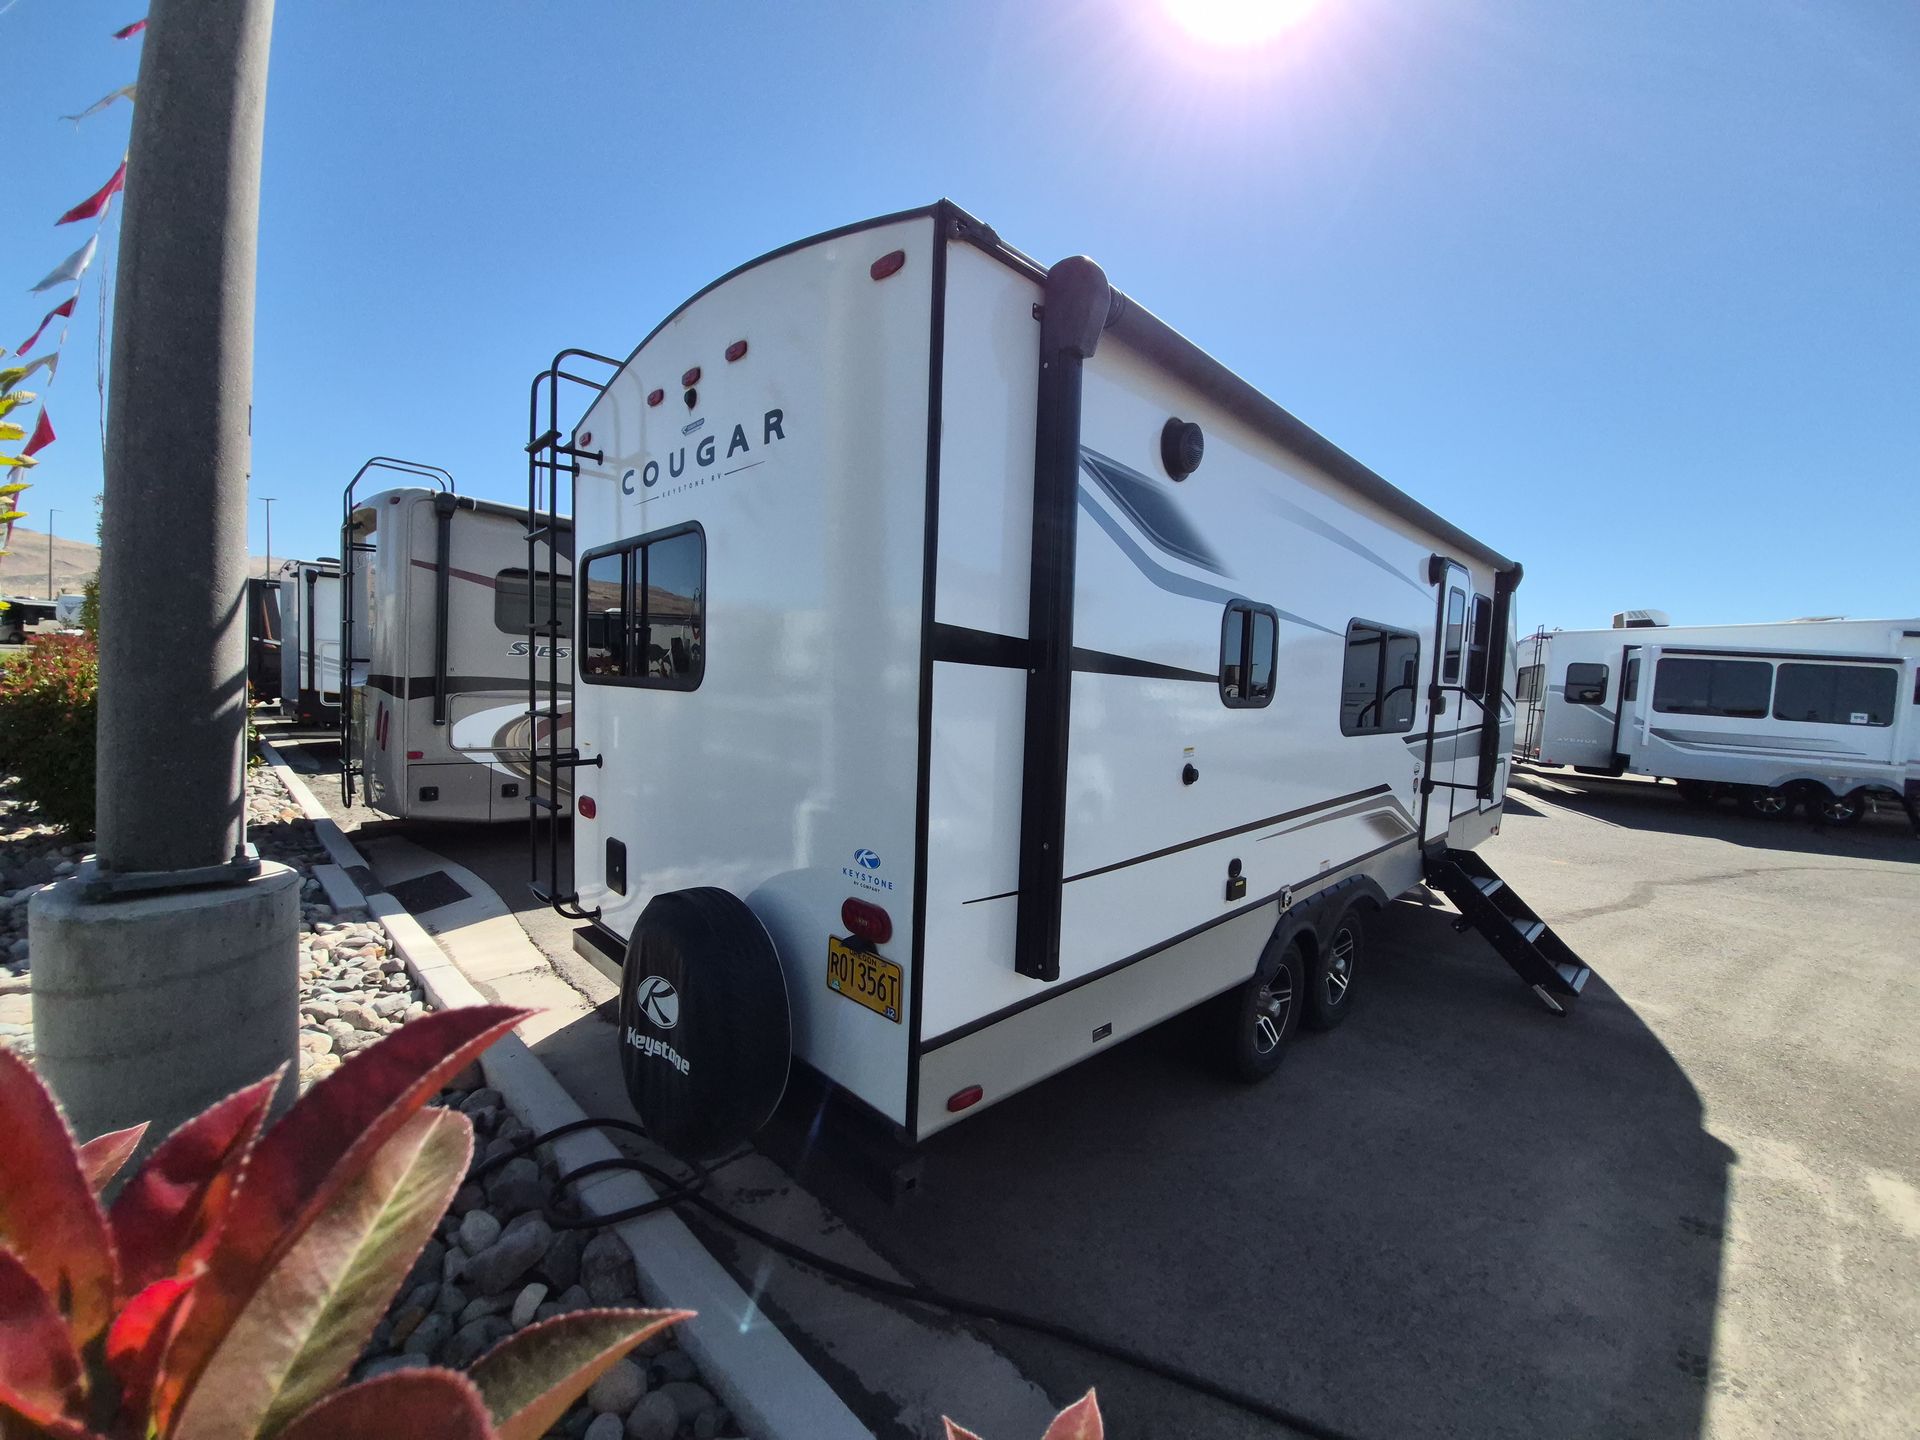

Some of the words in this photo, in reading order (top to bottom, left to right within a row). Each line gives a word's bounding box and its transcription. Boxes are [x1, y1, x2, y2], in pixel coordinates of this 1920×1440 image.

[621, 408, 786, 496] COUGAR
[842, 867, 893, 890] KEYSTONE
[830, 951, 898, 1007] R01356T
[626, 1026, 690, 1076] Keystone
